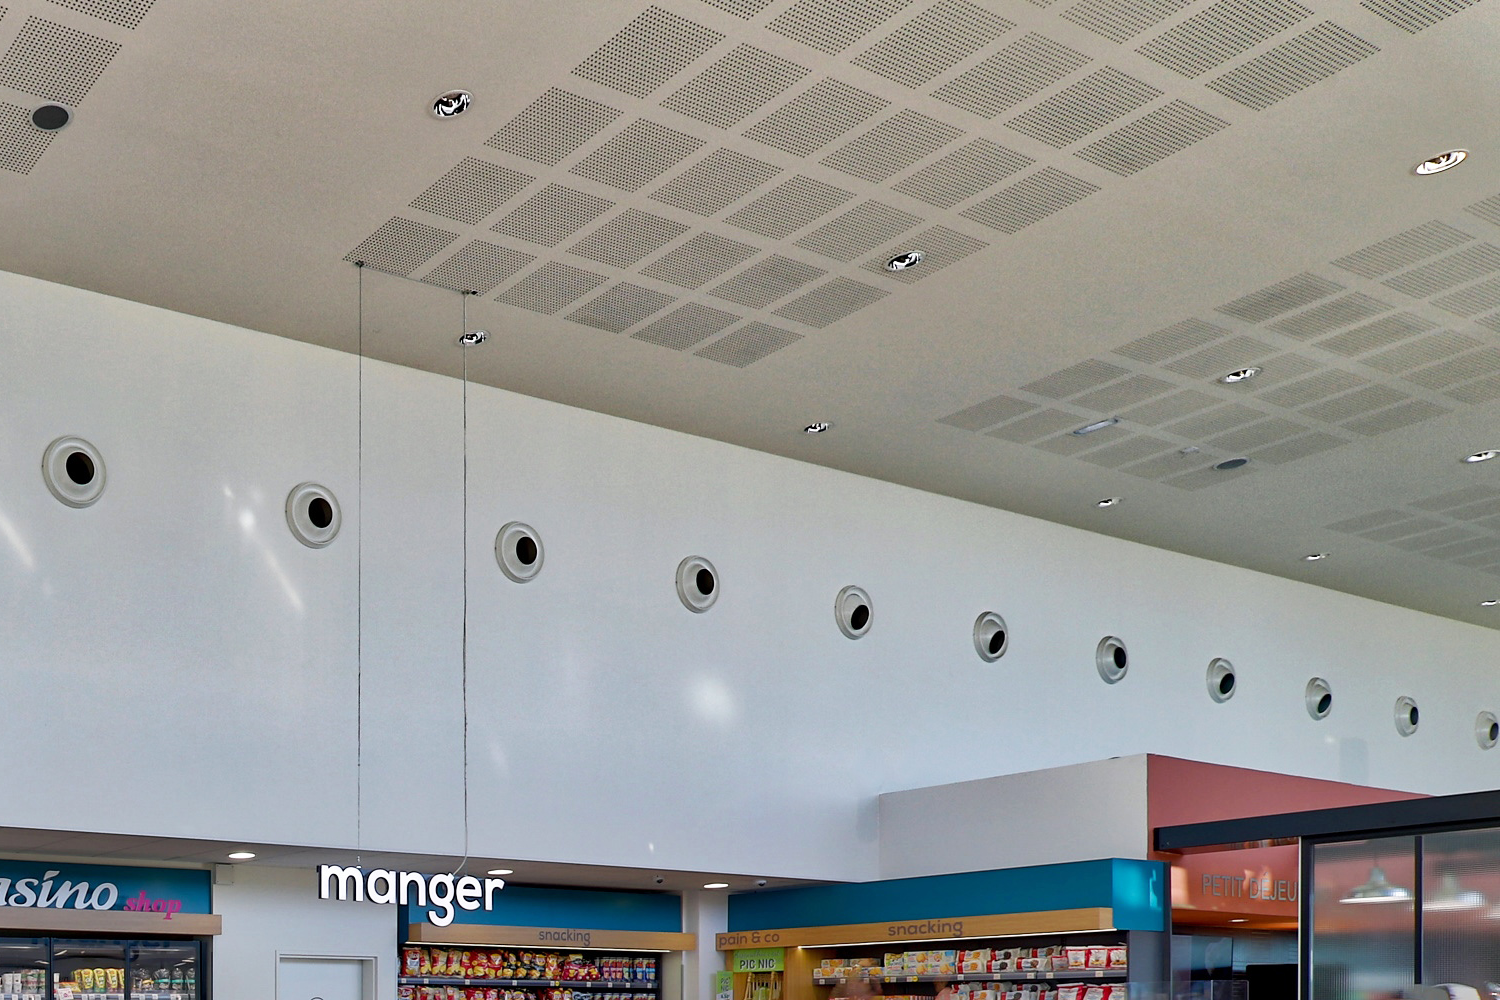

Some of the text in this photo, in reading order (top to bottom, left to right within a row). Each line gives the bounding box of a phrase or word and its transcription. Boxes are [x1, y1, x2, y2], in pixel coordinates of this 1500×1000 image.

[1202, 874, 1244, 898] PETIT
[318, 864, 505, 927] manger
[123, 890, 182, 920] shop
[538, 929, 591, 946] snacking
[888, 920, 964, 938] snacking
[719, 932, 780, 948] pain & co
[739, 958, 776, 970] PIC NIC
